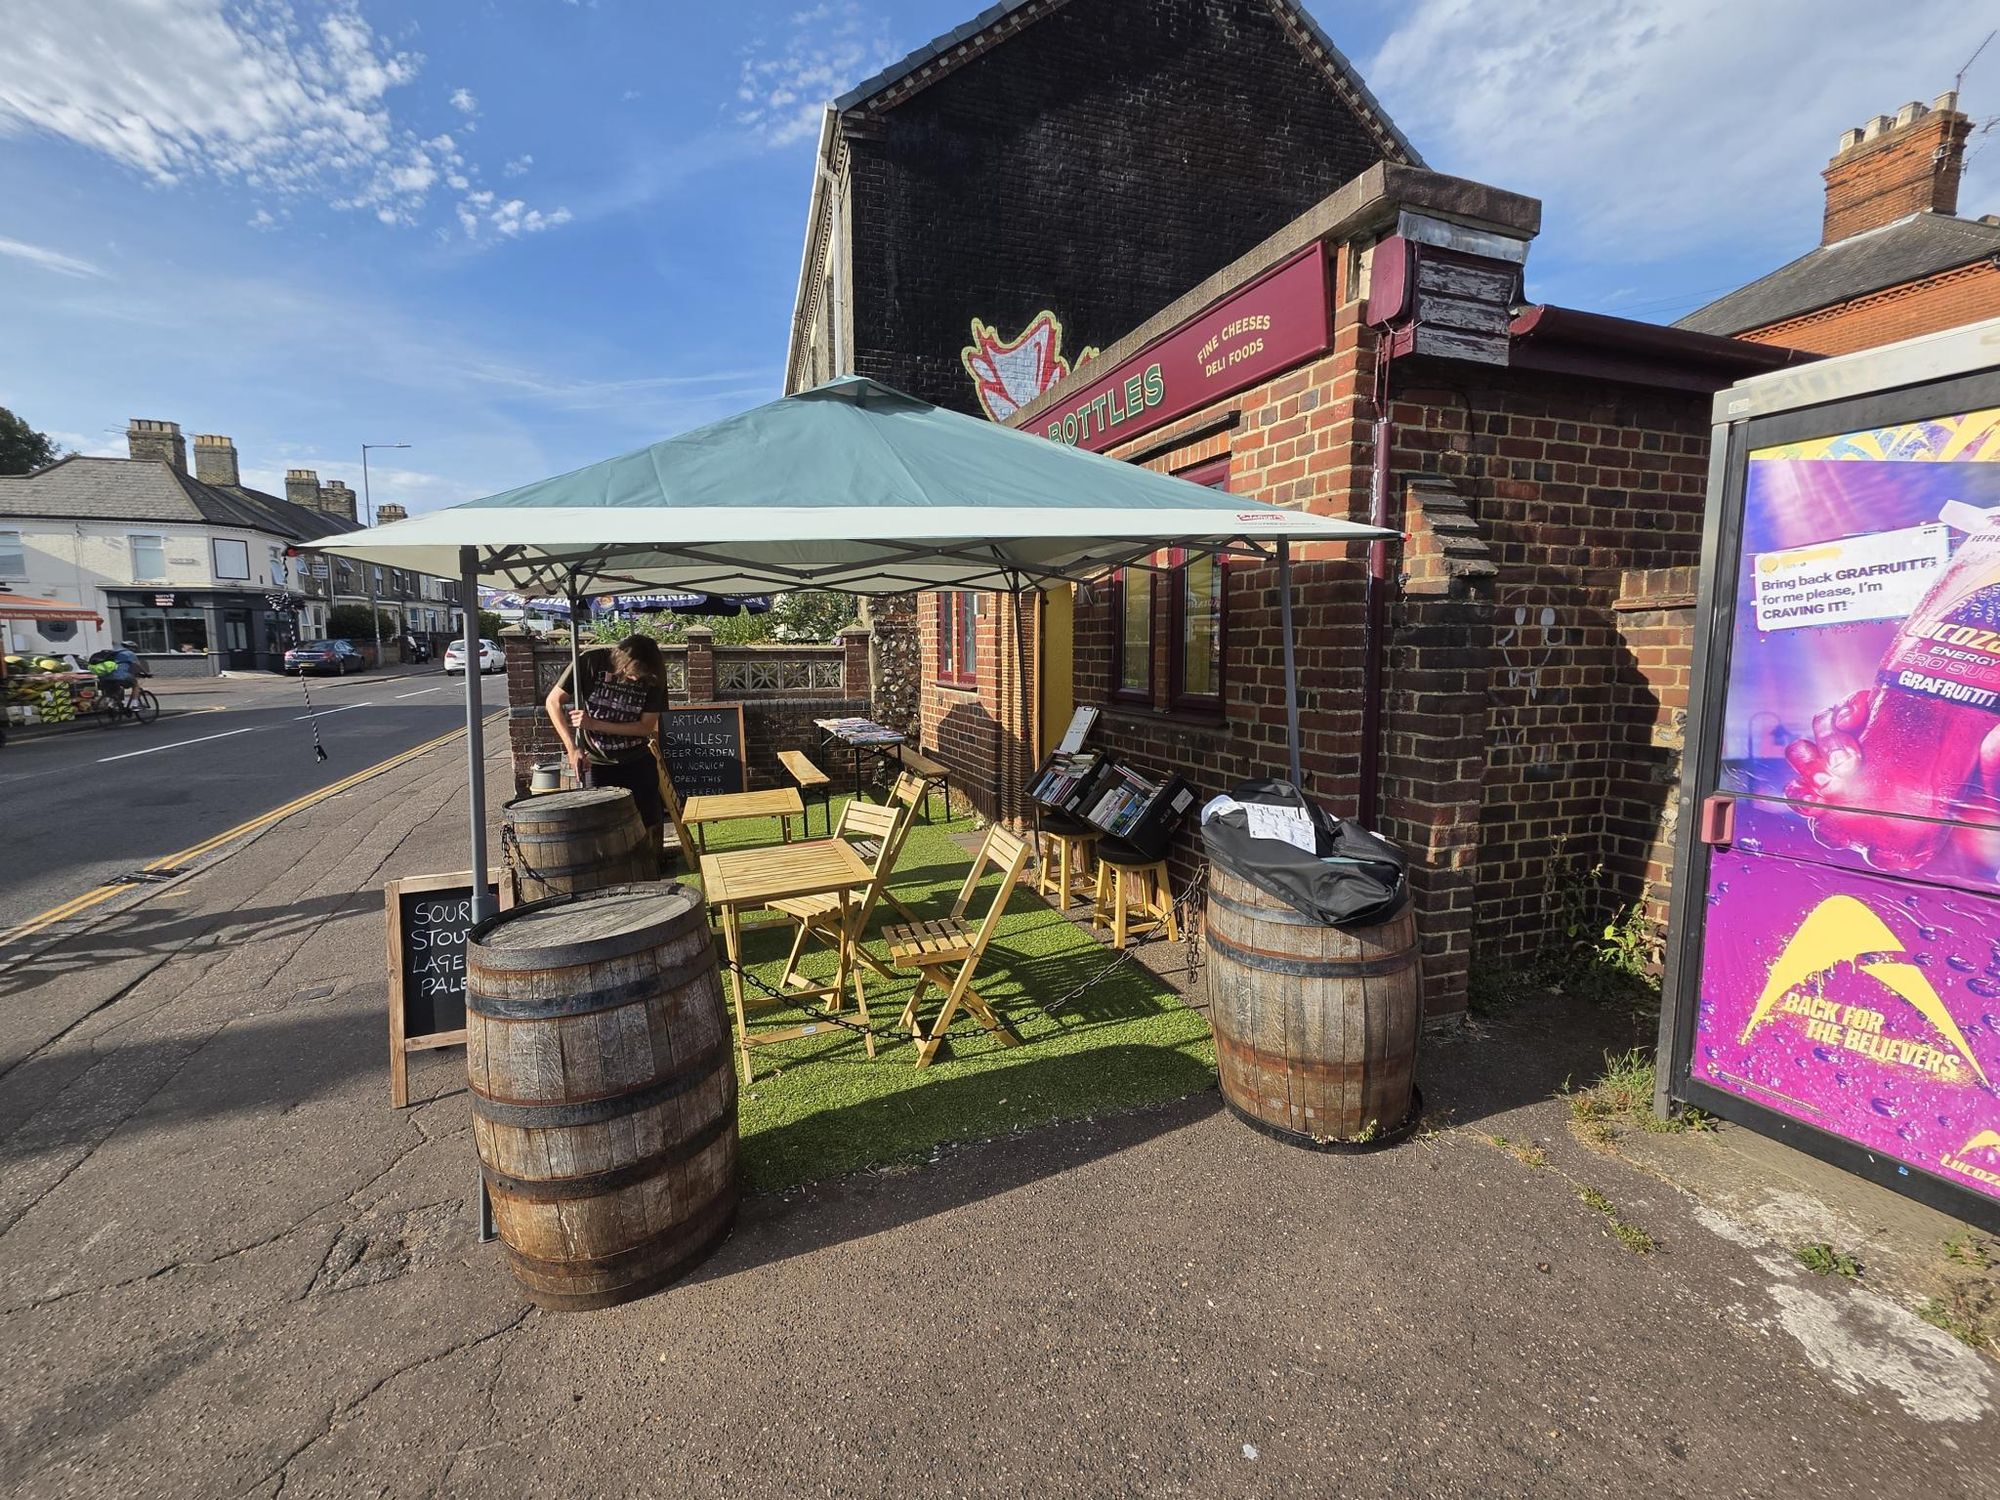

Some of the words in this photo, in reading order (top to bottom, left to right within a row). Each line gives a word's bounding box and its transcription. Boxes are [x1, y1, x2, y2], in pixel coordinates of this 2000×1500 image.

[1197, 335, 1219, 365] FINE
[1222, 314, 1271, 341] CHEESES
[1205, 358, 1226, 378] DELI
[1228, 337, 1264, 364] FOODS
[1047, 363, 1164, 446] BOTTLES
[1761, 578, 1796, 592] Bring
[1799, 572, 1832, 586] back
[1762, 592, 1779, 605] for
[1782, 591, 1805, 602] me
[1806, 584, 1856, 604] please,
[1859, 581, 1883, 593] I'm
[1762, 603, 1825, 620] CRAVING
[1827, 600, 1848, 614] IT!
[1929, 645, 2000, 666] ENERGY
[1900, 650, 1948, 671] ERO
[1946, 661, 2000, 685] SUG
[671, 713, 722, 727] ARTICANS
[665, 731, 732, 746] SMALLEST
[663, 749, 692, 759] BEER
[694, 747, 735, 758] GARDEN
[673, 762, 683, 770] IN
[688, 761, 725, 771] NORWICH
[674, 775, 697, 783] OPEN
[702, 775, 722, 783] THIS
[414, 901, 470, 925] SOUR
[413, 954, 464, 974] LAGE
[421, 976, 468, 998] PALE
[1784, 991, 1842, 1023] BACK
[1842, 1005, 1885, 1034] FOR
[1806, 1017, 1844, 1046] THE
[1843, 1029, 1961, 1079] BELIEVERS
